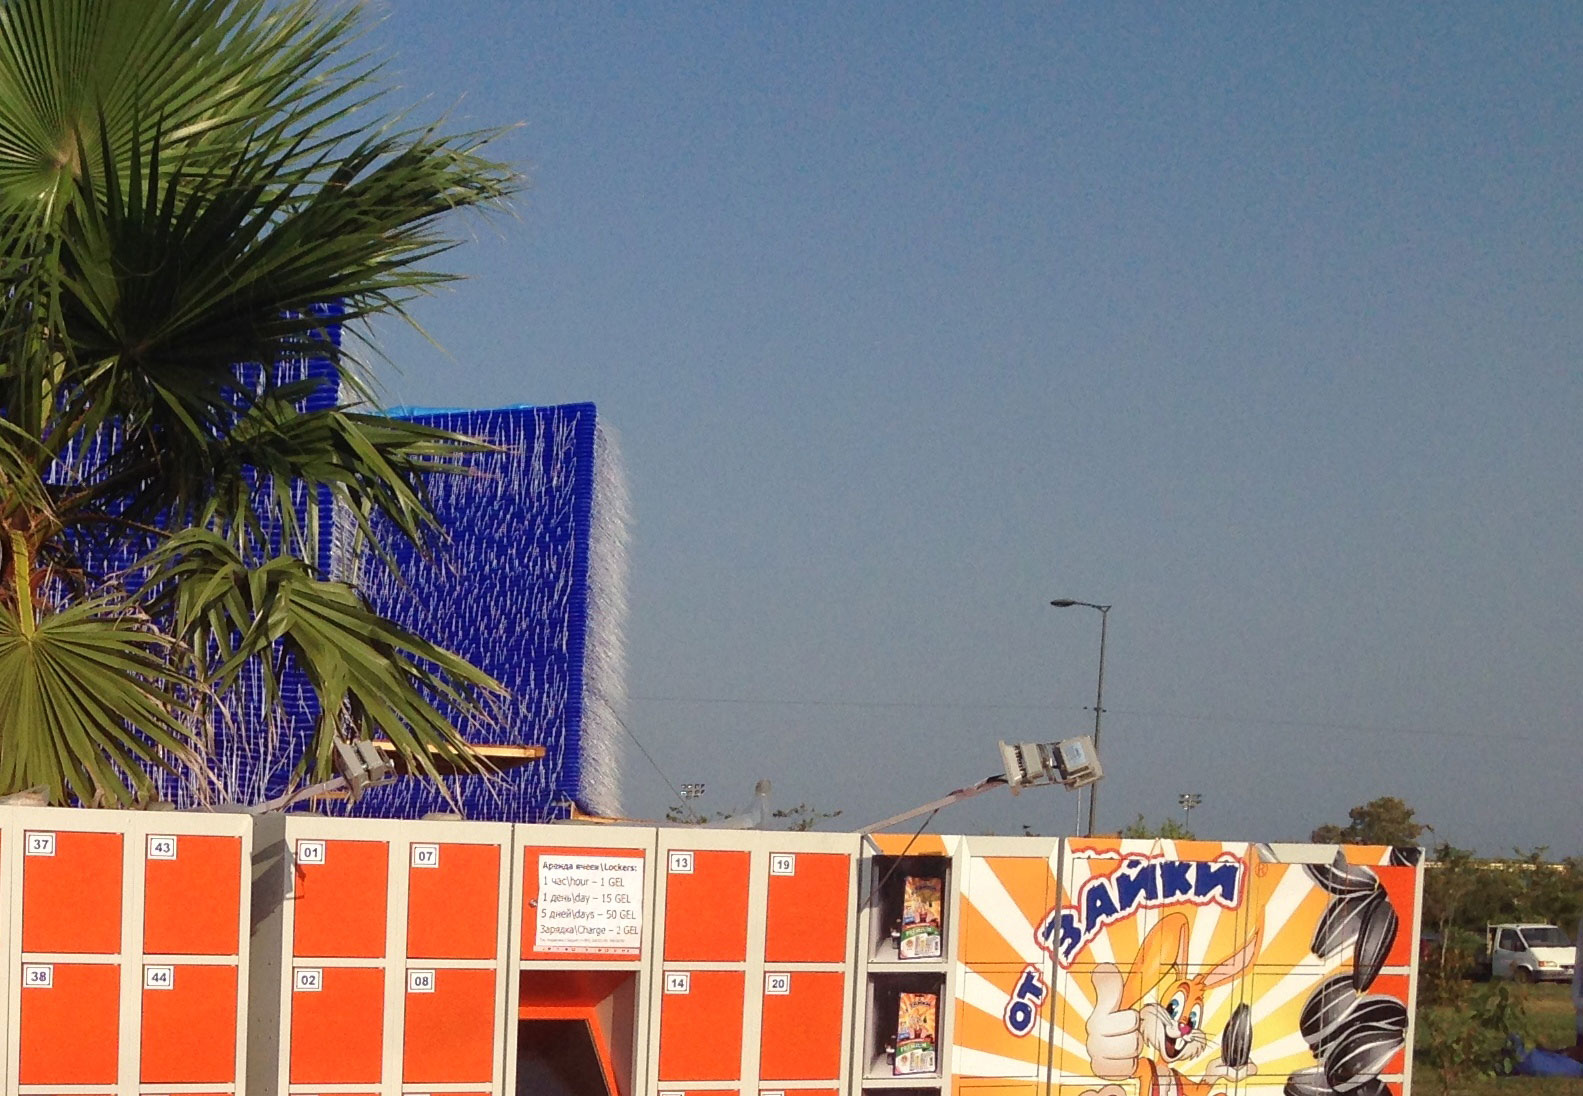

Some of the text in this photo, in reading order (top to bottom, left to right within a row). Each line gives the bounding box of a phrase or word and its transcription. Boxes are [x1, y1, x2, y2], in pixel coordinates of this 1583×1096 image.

[33, 839, 49, 850] 37
[154, 842, 171, 854] 43
[304, 847, 318, 858] 01
[418, 851, 433, 862] 07
[675, 857, 688, 868] 13
[777, 859, 790, 870] 19
[543, 876, 548, 886] 1
[600, 878, 605, 886] 1
[608, 878, 625, 887] GEL
[543, 893, 548, 902] 1
[602, 894, 612, 903] 15
[614, 894, 631, 904] GEL
[541, 909, 547, 918] 5
[606, 909, 617, 919] 50
[619, 910, 636, 920] GEL
[1040, 859, 1240, 960] ЗАЙКИ
[616, 926, 621, 935] 2
[623, 926, 638, 935] GEL
[31, 971, 47, 982] 38
[151, 972, 167, 983] 44
[301, 975, 316, 986] 02
[414, 976, 429, 987] 08
[671, 978, 685, 988] 14
[772, 979, 785, 989] 20
